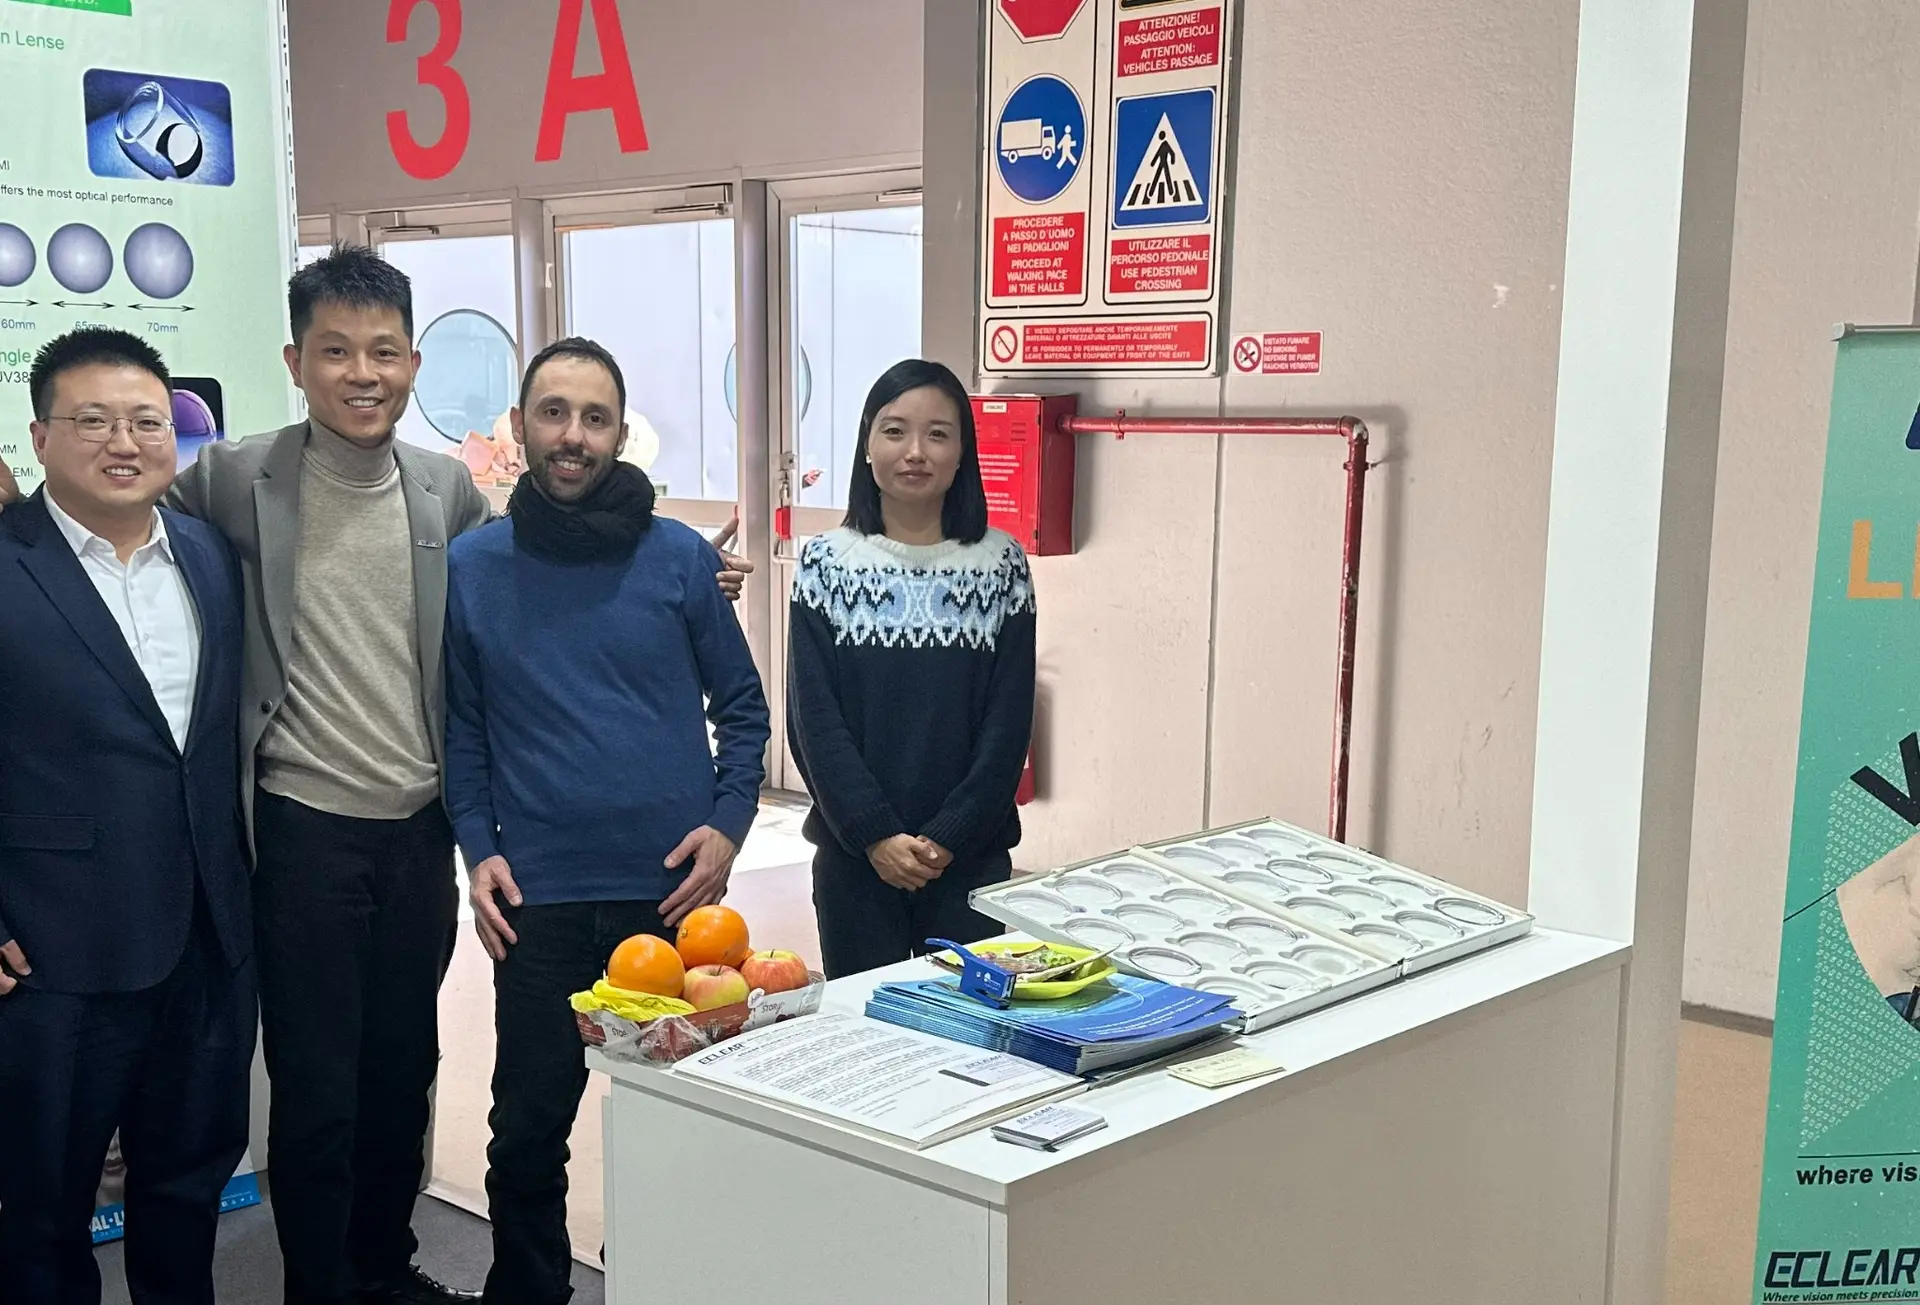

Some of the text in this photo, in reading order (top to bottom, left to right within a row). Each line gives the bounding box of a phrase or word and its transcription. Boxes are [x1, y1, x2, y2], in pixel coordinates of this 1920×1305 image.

[1138, 12, 1200, 31] ATTENZIONE!
[16, 30, 64, 50] Lense
[1124, 24, 1214, 46] PASSAGGIO VEICOLI
[1141, 43, 1196, 59] ATTENTION:
[1123, 53, 1213, 74] VEHICLES PASSAGE
[386, 0, 649, 180] 3 A
[27, 186, 44, 197] the
[47, 189, 72, 199] most
[75, 190, 108, 202] optical
[111, 193, 173, 207] performance
[1013, 216, 1064, 229] PROCEDERE
[1002, 232, 1009, 242] A
[1010, 230, 1038, 241] PASSO
[1007, 241, 1069, 253] NEI PADIGLIONI
[1128, 238, 1191, 251] UTILIZZARE IL
[1011, 257, 1064, 269] PROCEED AT
[1111, 250, 1209, 265] PERCORSO PEDONALE
[1007, 270, 1068, 282] WALKING PACE
[1121, 265, 1198, 279] USE PEDESTRIAN
[1008, 282, 1064, 293] IN THE HALLS
[1134, 278, 1182, 290] CROSSING
[1, 318, 36, 330] 60mm
[147, 322, 179, 333] 70mm
[0, 370, 31, 384] V38
[1796, 1161, 1920, 1185] where vis
[1764, 1247, 1920, 1288] ECLEAR
[1763, 1288, 1919, 1302] Where vision meets precision
